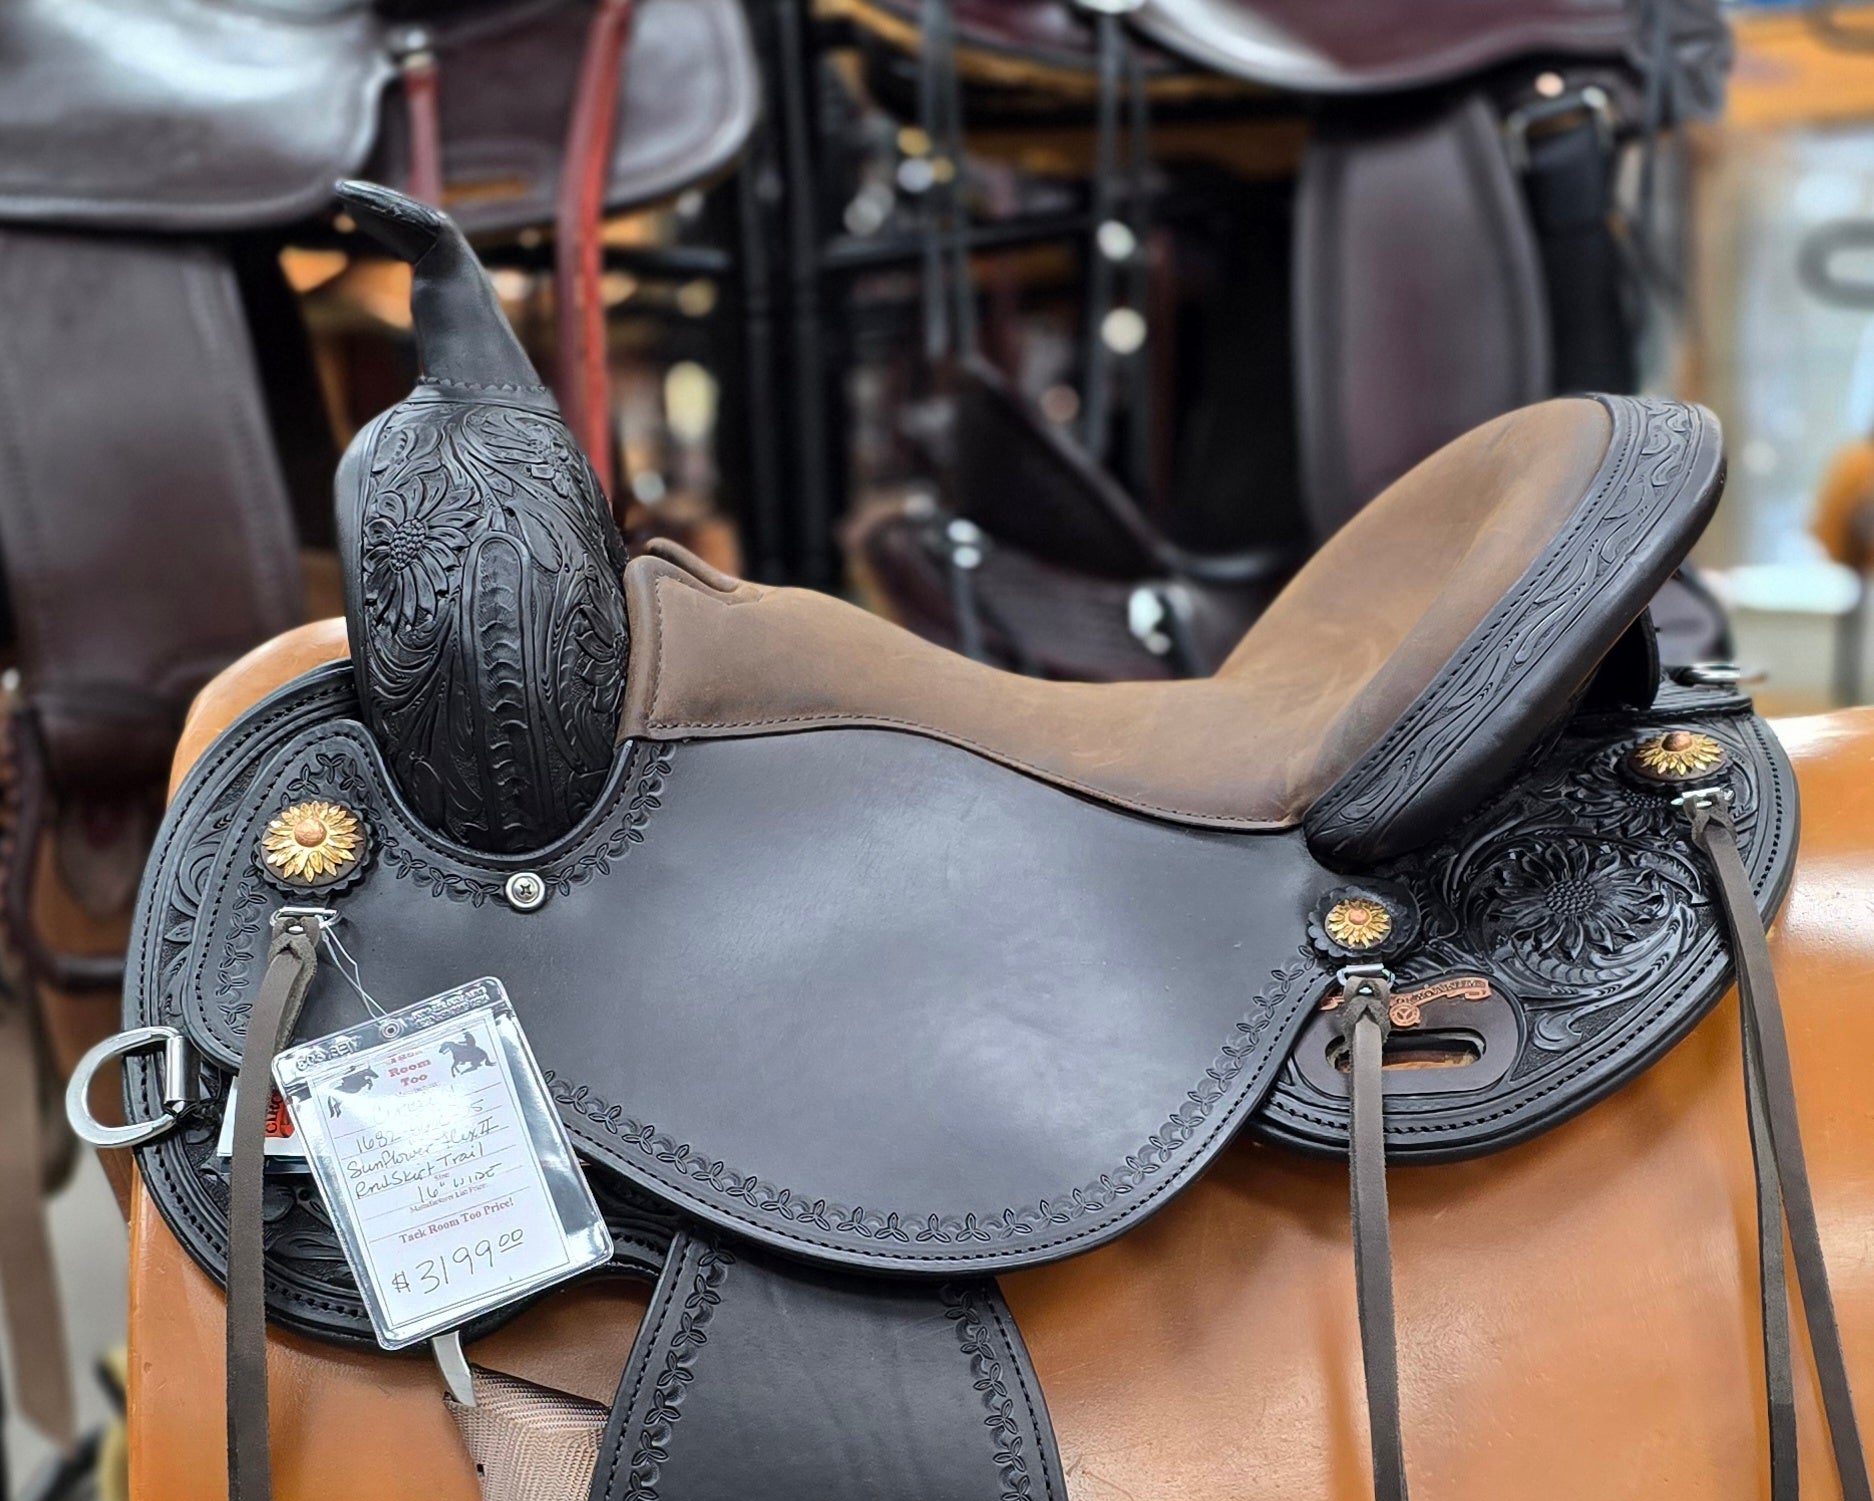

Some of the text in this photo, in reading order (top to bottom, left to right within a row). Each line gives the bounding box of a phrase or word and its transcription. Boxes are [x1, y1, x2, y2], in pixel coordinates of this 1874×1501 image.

[398, 1196, 515, 1245] Tack Room Too Price!
